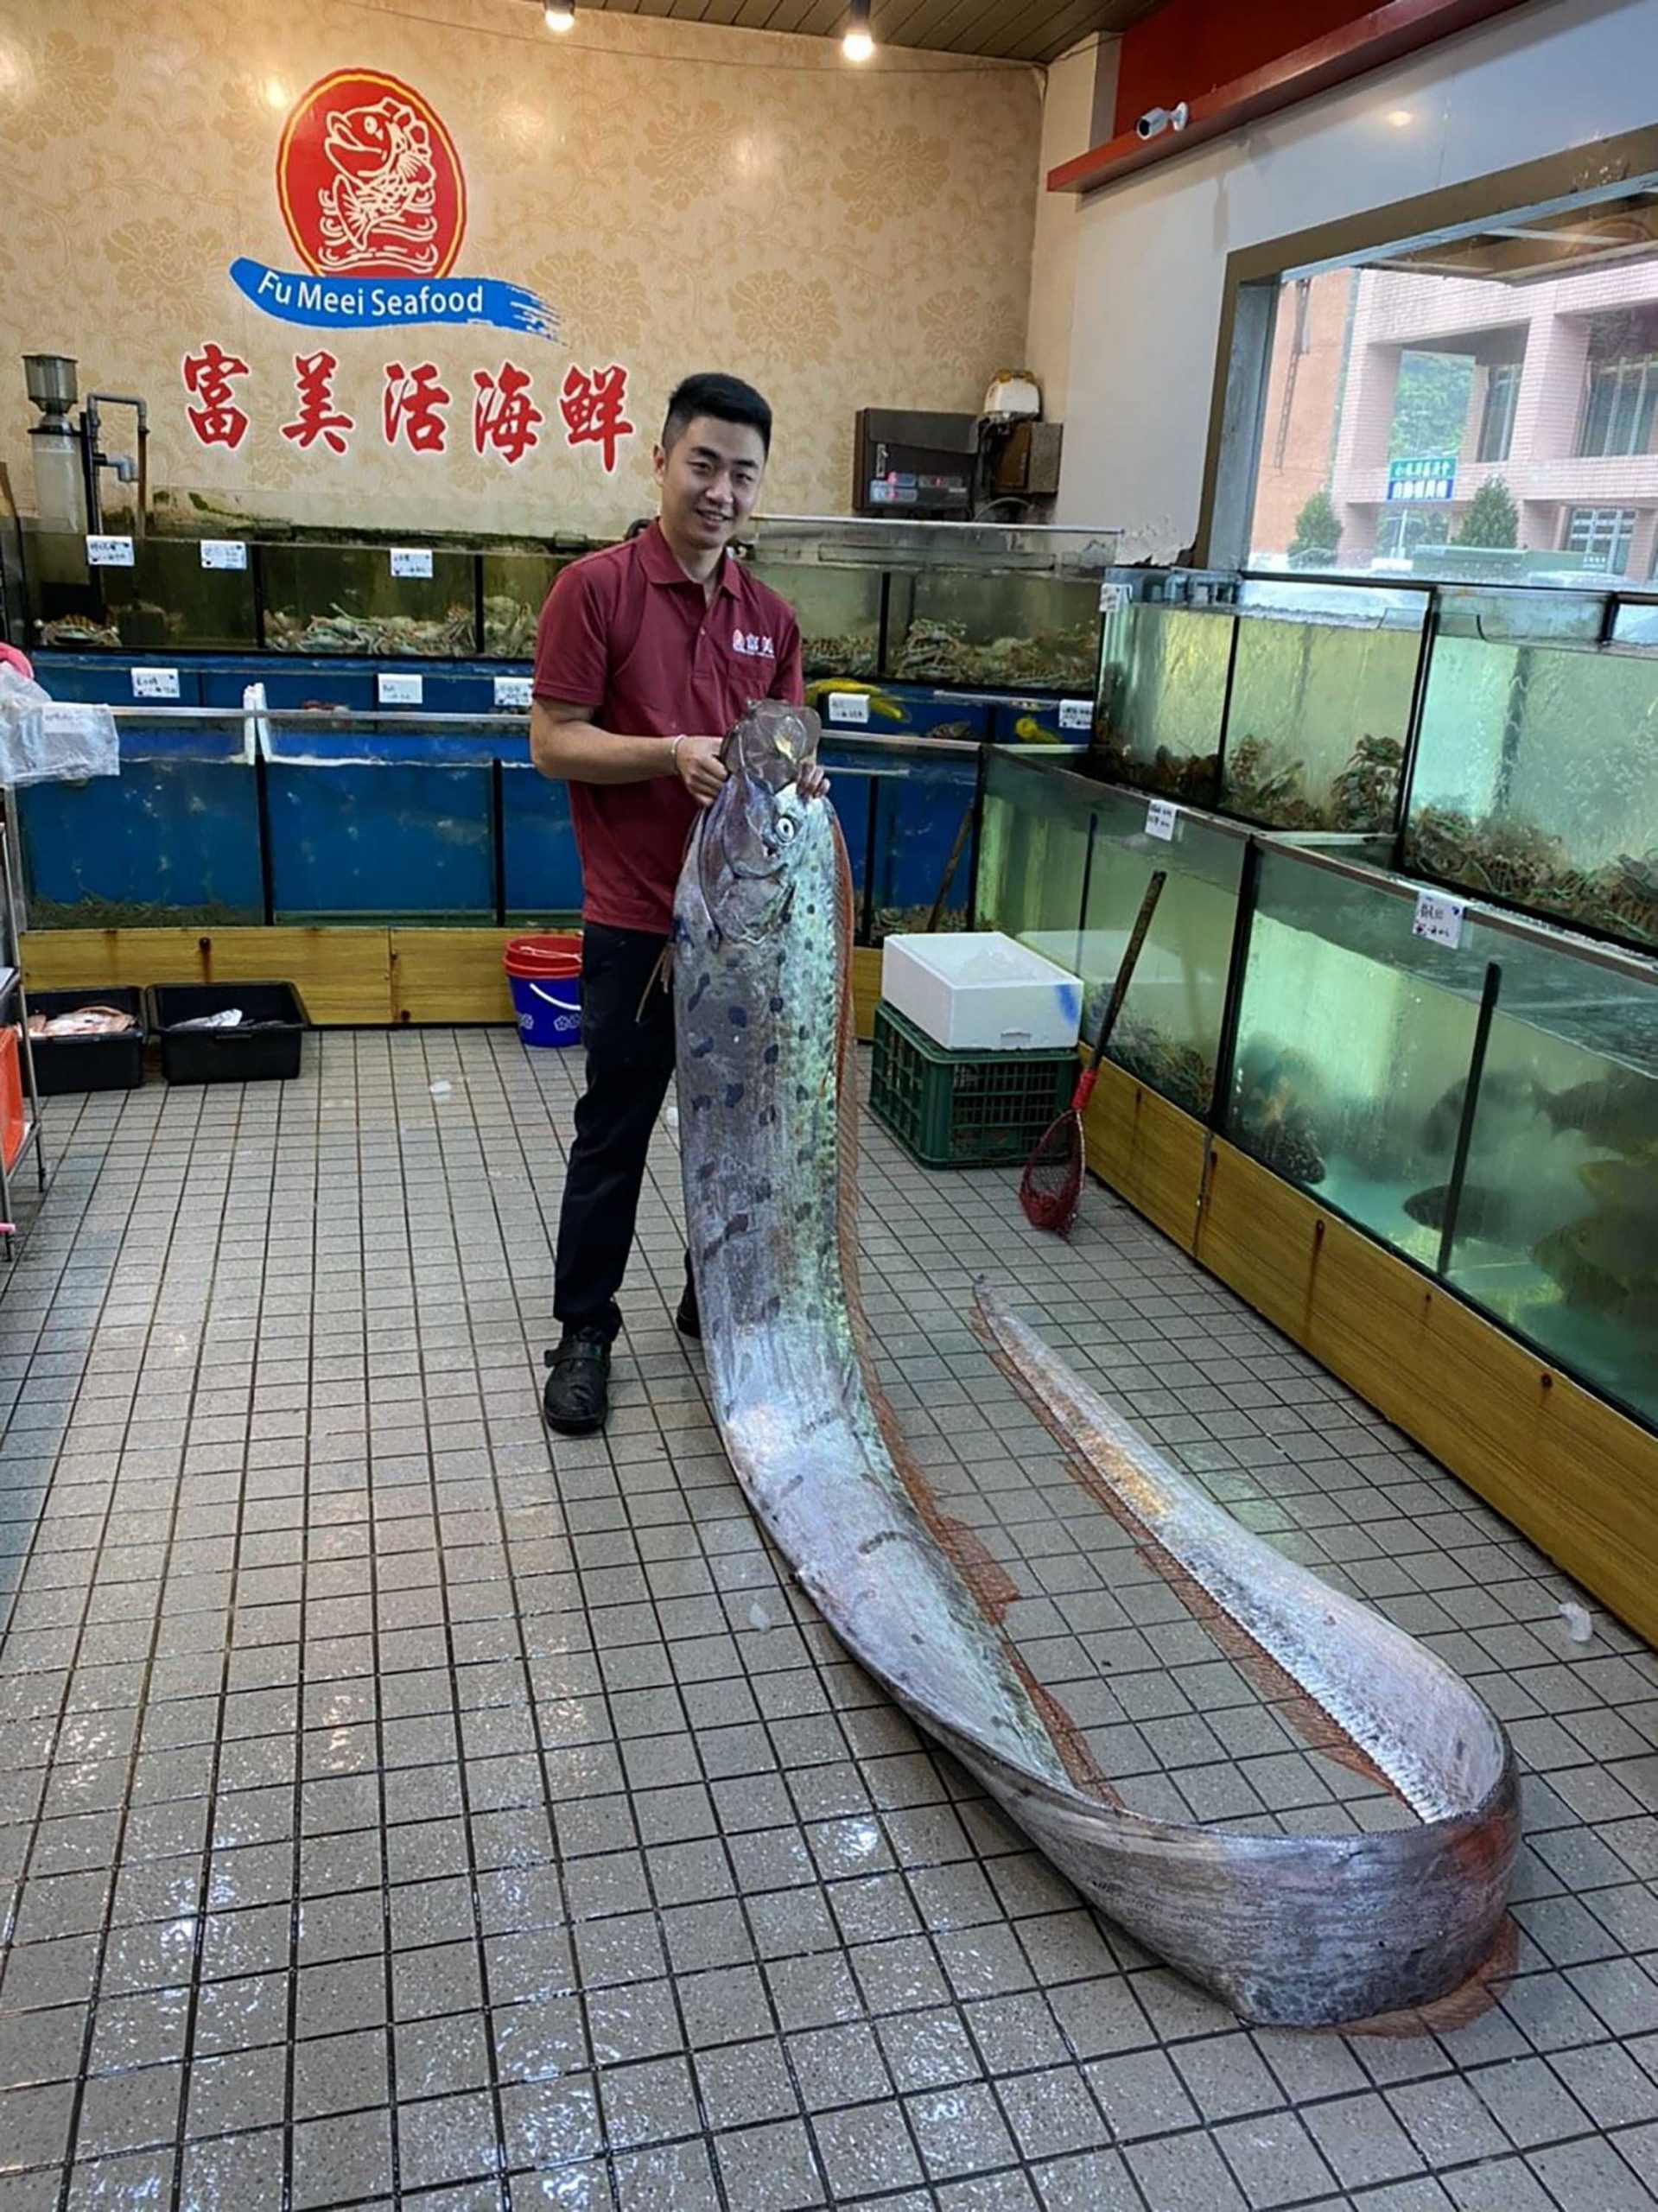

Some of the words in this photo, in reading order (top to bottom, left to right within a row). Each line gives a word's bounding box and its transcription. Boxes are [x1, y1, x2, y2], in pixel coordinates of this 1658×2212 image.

[257, 270, 292, 304] Fu
[297, 281, 364, 315] Meei
[371, 285, 483, 316] Seafood
[183, 342, 633, 473] 富美活海鮮
